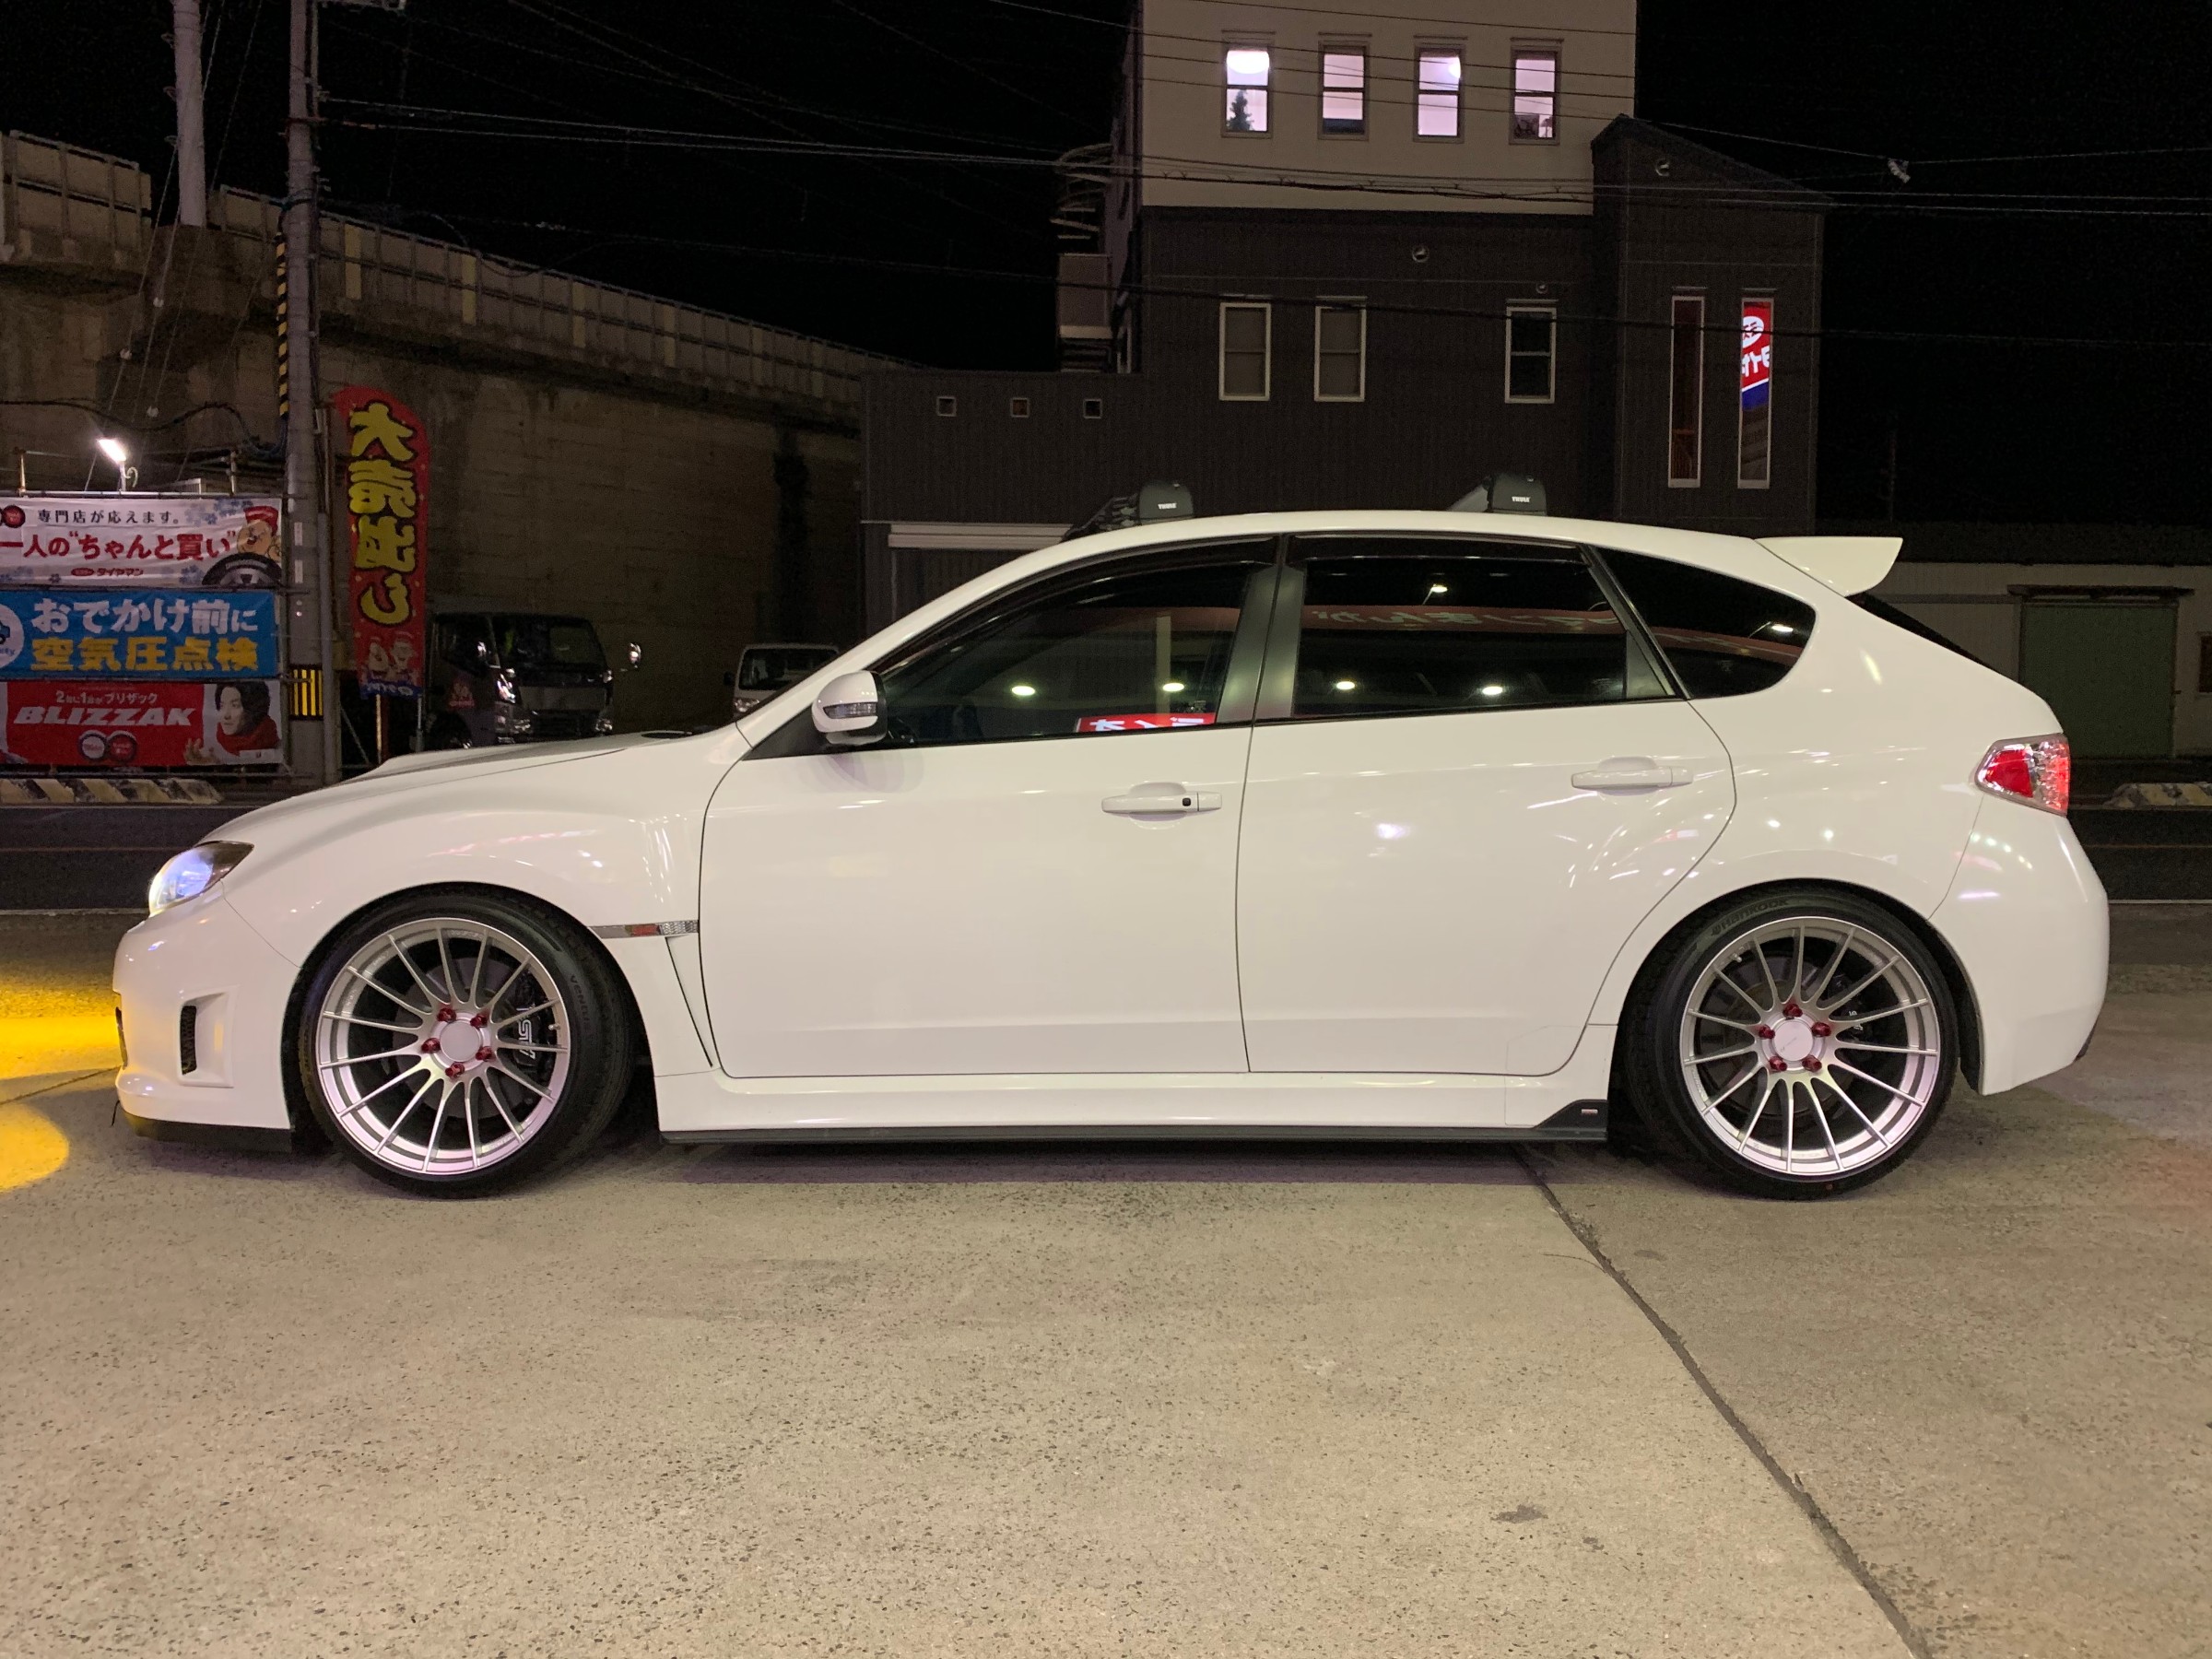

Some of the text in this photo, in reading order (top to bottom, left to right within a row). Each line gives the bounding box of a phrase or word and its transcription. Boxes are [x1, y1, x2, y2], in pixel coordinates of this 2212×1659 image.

[38, 509, 180, 524] 専門店が応えます。
[30, 598, 259, 634] おでかけ前に
[30, 637, 259, 672] 空気圧点検
[13, 706, 197, 726] BLIZZAK
